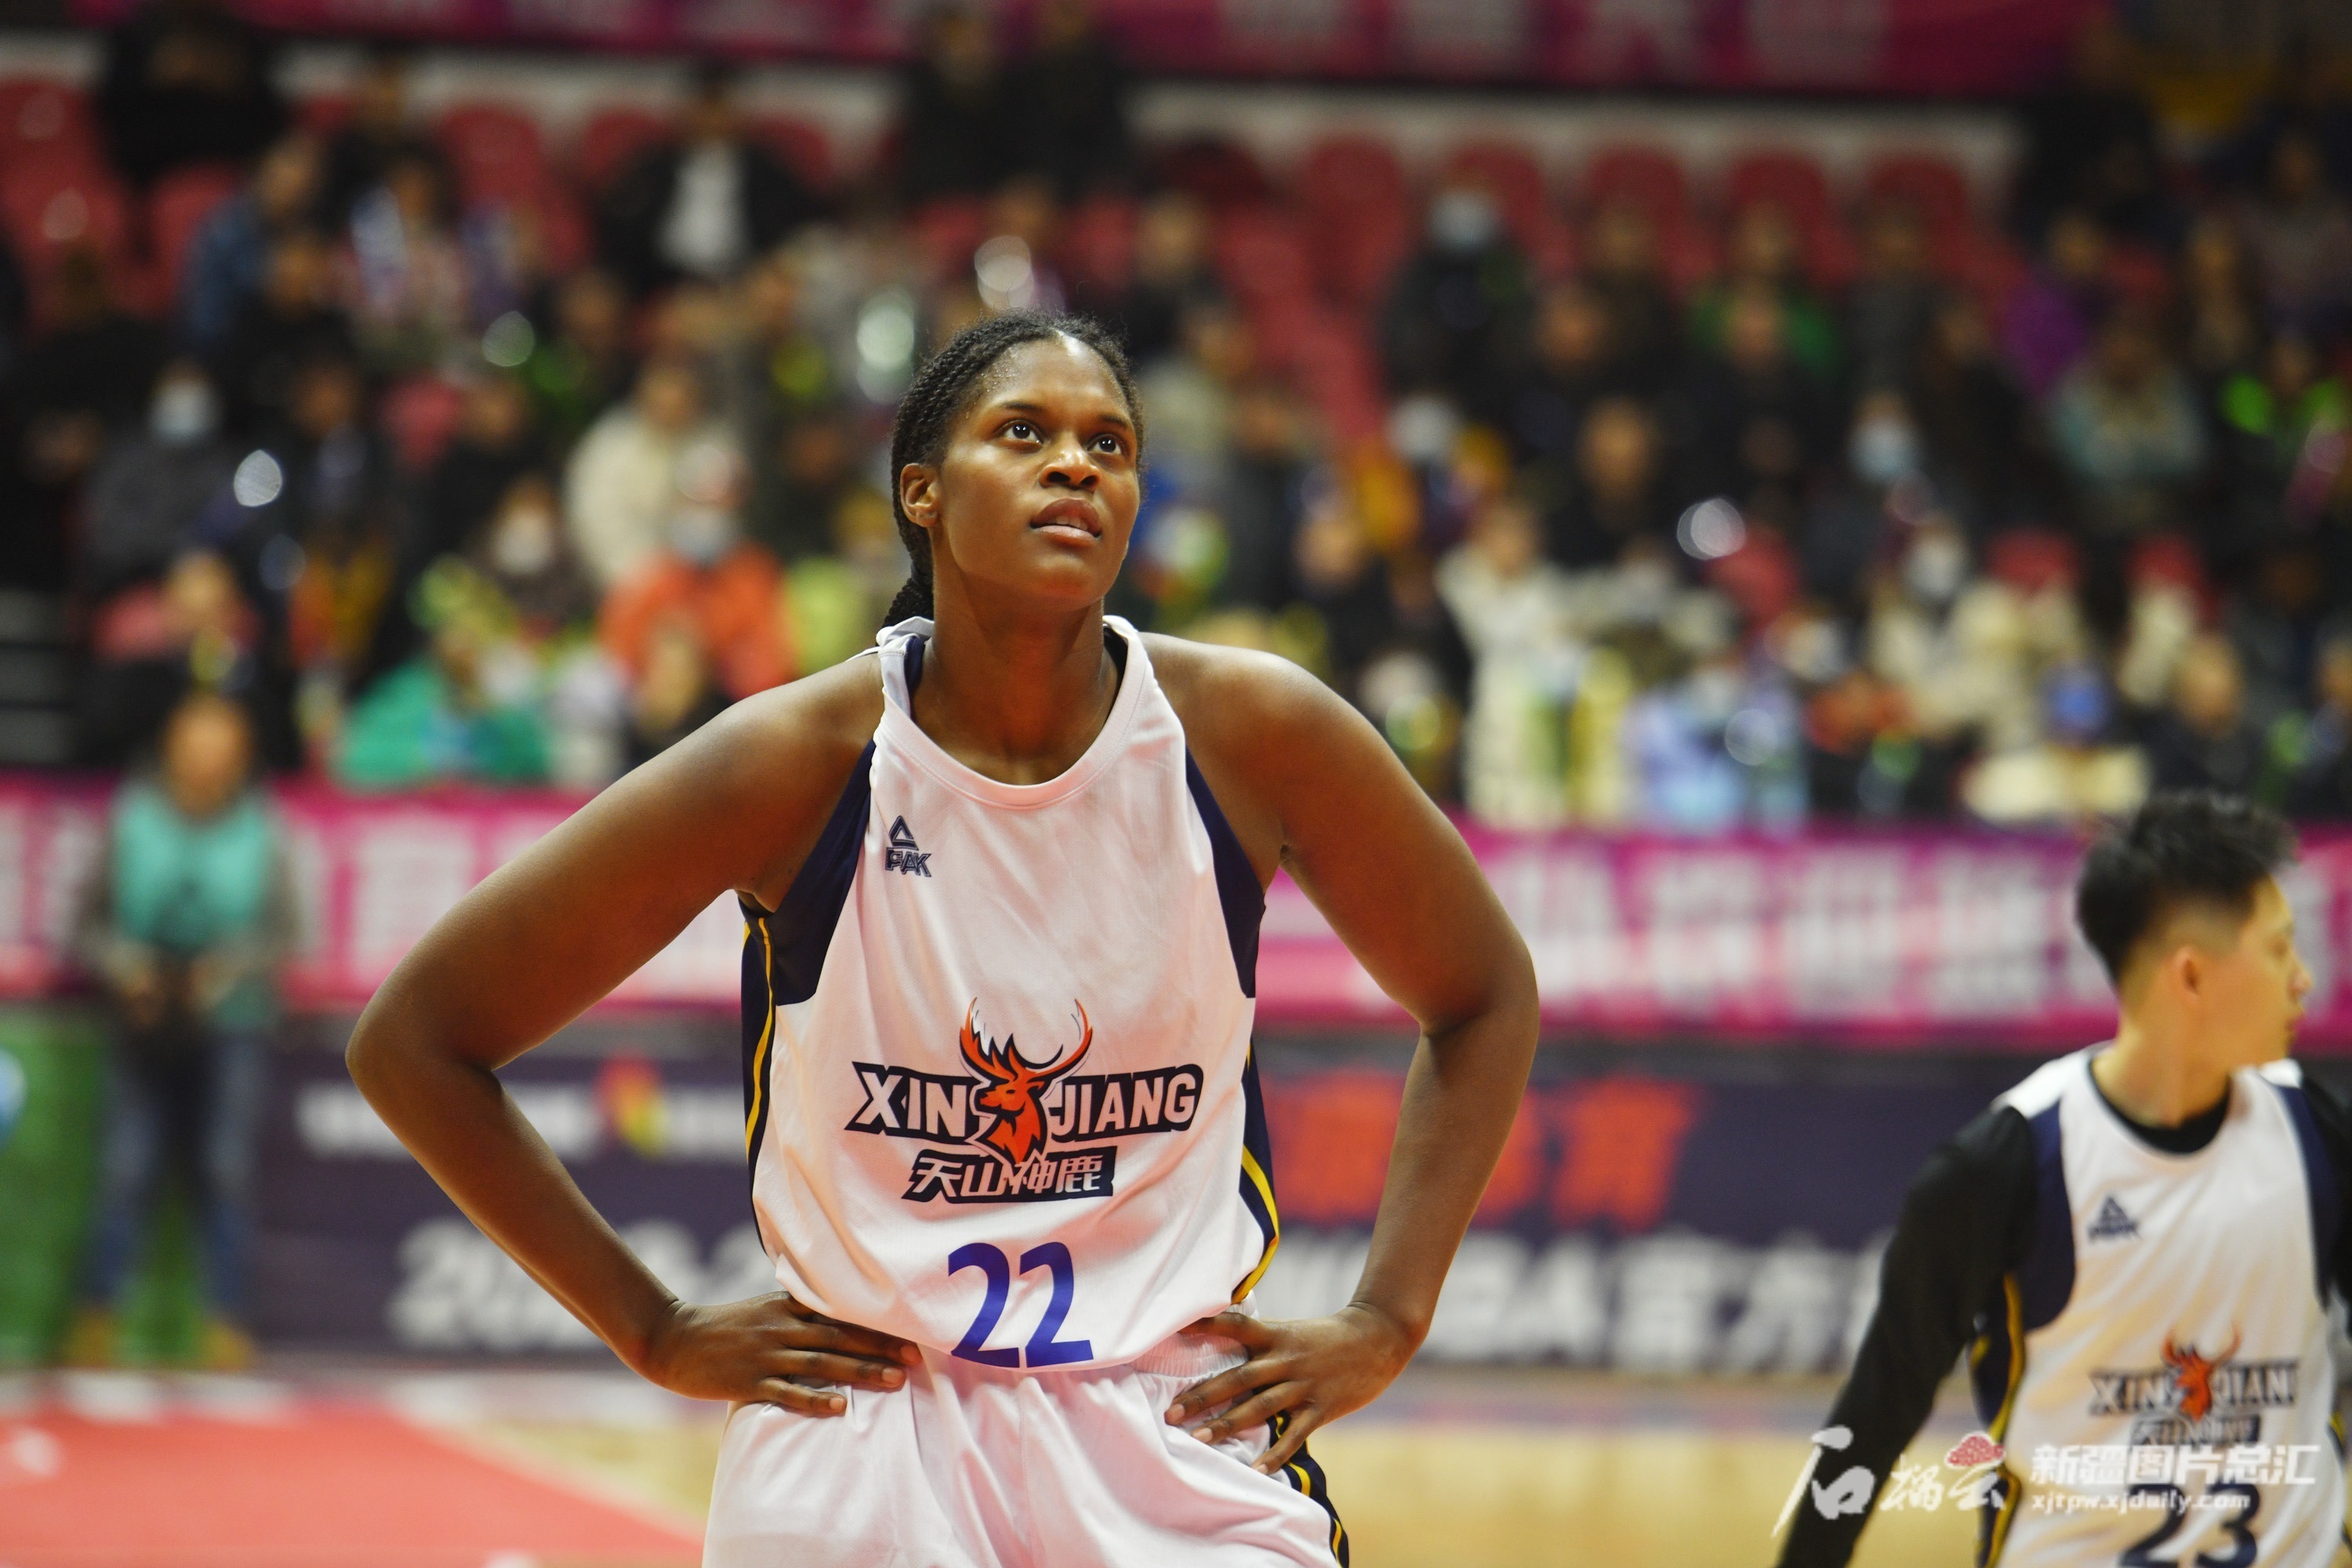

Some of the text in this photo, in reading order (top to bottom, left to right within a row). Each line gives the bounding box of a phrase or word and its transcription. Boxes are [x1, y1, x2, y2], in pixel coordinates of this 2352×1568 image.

[853, 1069, 1196, 1138] XIN JIANG
[912, 1154, 1103, 1196] 天山神鹿
[947, 1242, 1094, 1369] 22
[2119, 1482, 2259, 1568] 23
